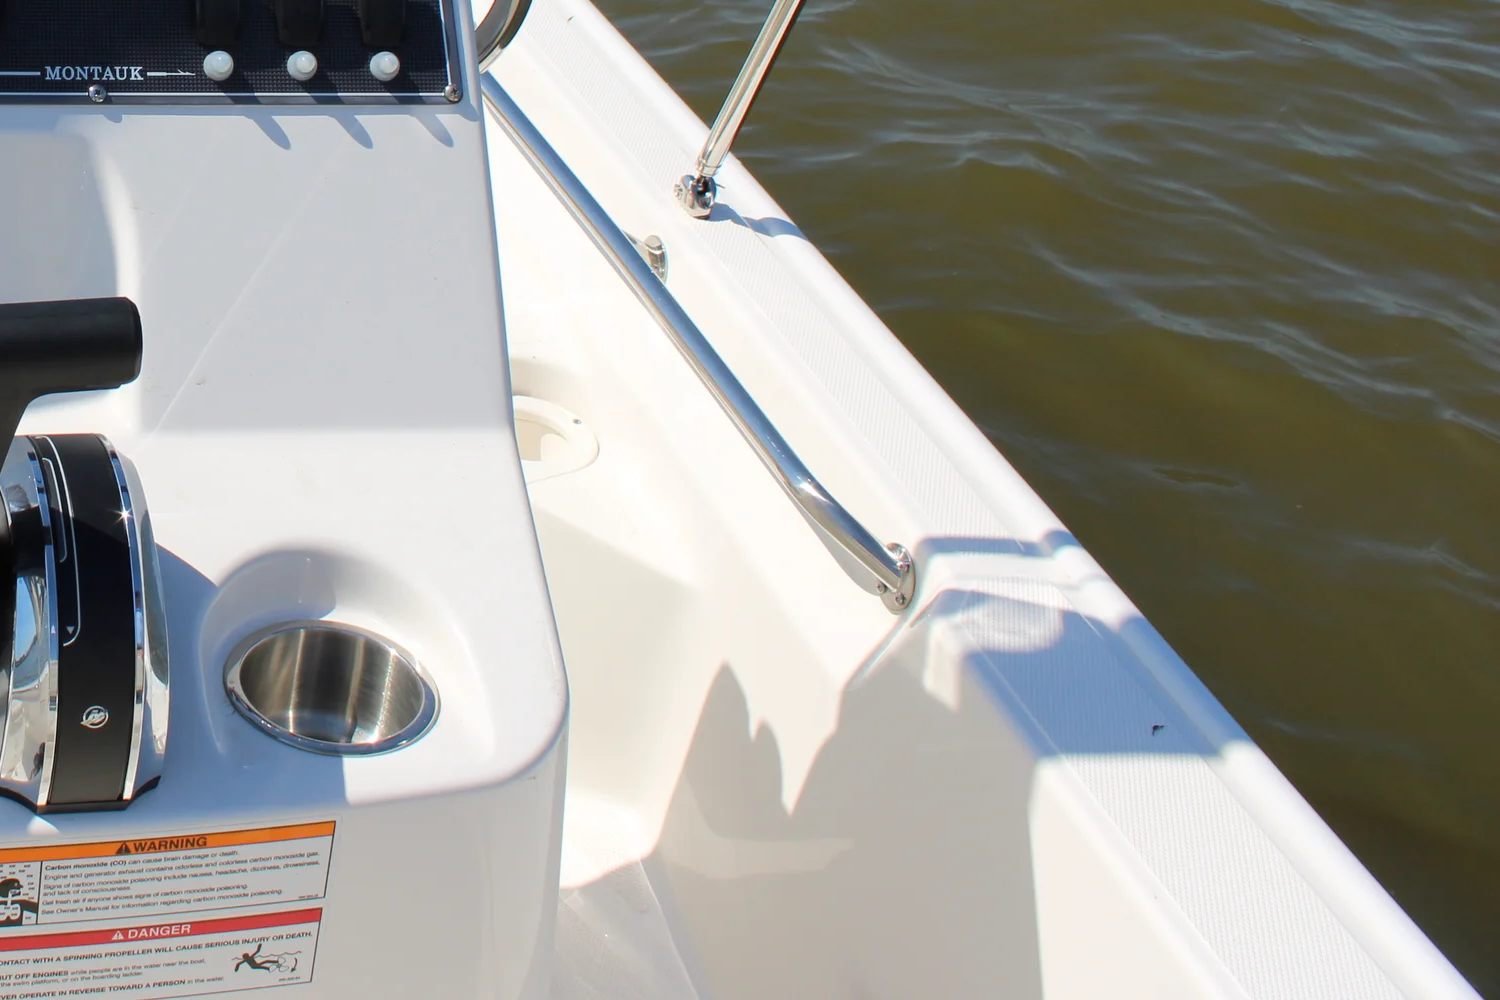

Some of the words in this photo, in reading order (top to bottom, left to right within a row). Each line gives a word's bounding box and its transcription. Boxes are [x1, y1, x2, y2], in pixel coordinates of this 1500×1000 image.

[45, 66, 144, 80] MONTAUK
[133, 836, 208, 853] WARNING
[110, 860, 127, 868] (CO)
[182, 853, 209, 861] damage
[128, 924, 192, 939] DANGER
[33, 956, 54, 964] WITH
[63, 952, 102, 961] SPINNING
[104, 948, 152, 958] PROPELLER
[154, 946, 174, 954] WILL
[176, 944, 203, 952] CAUSE
[205, 940, 240, 948] SERIOUS
[242, 936, 270, 944] INJURY
[286, 931, 312, 939] DEATH.
[32, 970, 68, 978] ENGINES
[19, 990, 56, 999] OPERATE
[69, 987, 106, 995] REVERSE
[108, 984, 144, 992] TOWARD
[152, 980, 186, 988] PERSON
